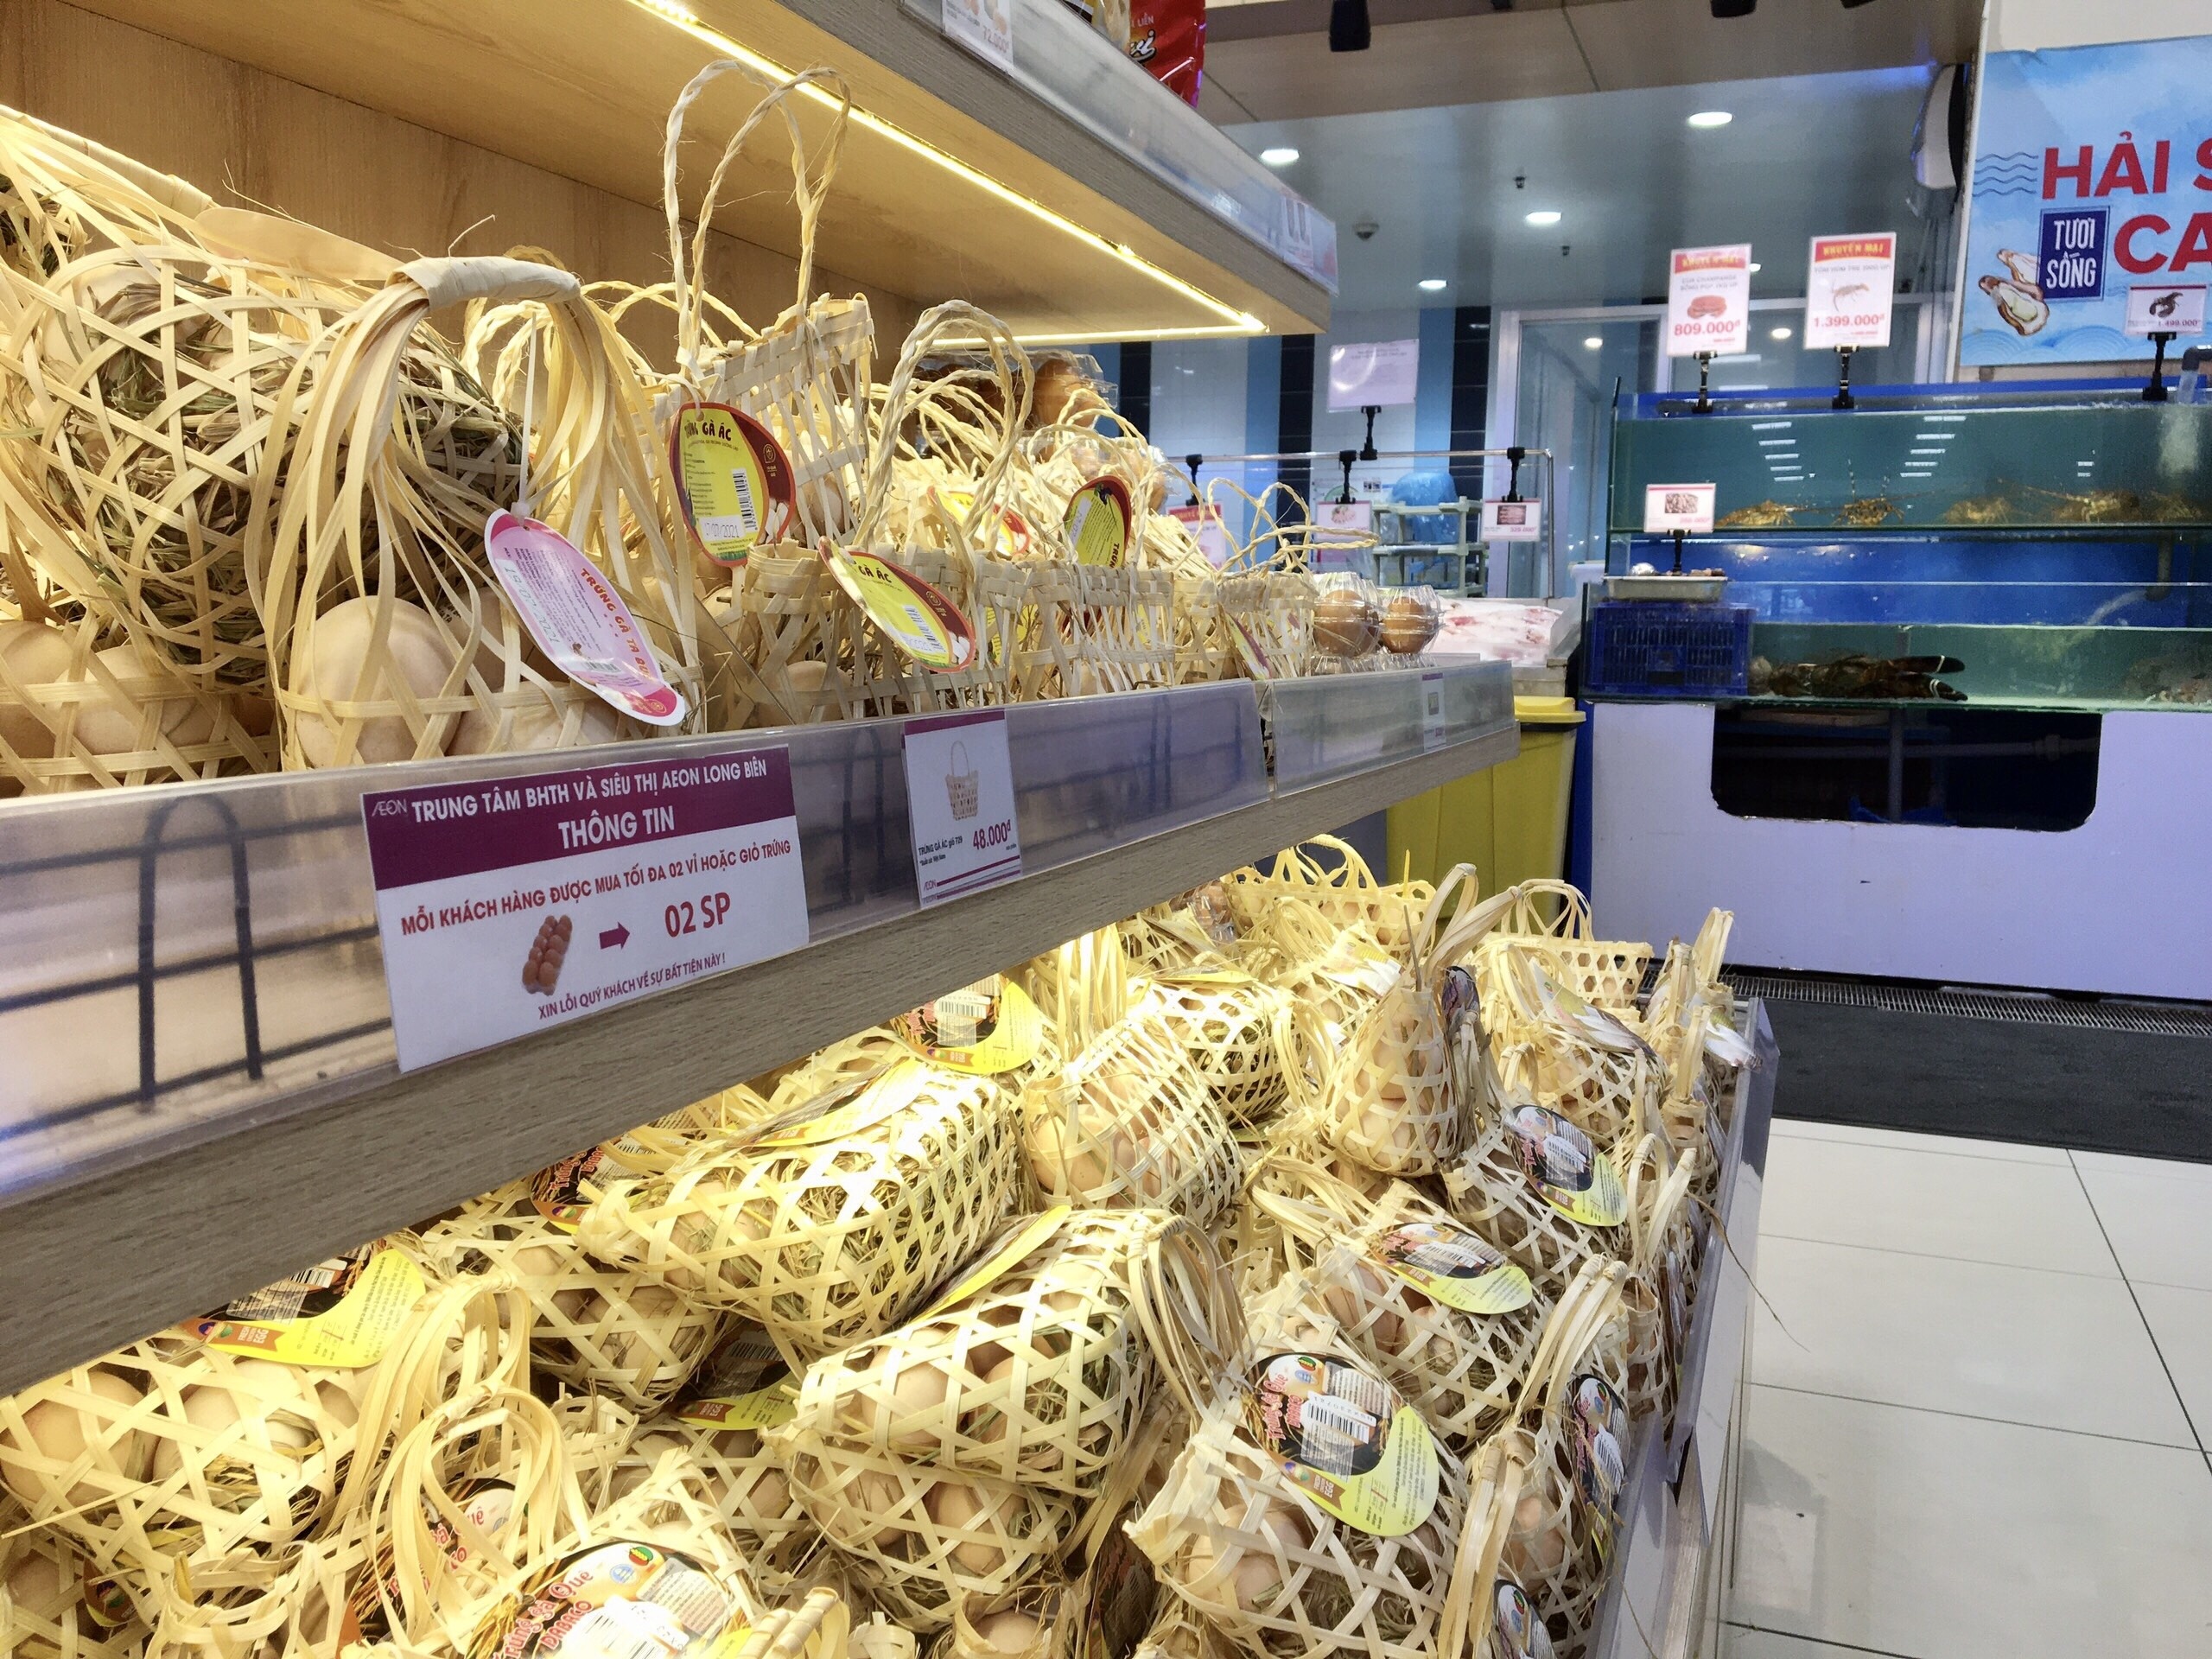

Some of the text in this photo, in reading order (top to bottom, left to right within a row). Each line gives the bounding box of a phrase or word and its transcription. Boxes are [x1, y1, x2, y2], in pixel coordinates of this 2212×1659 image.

[2042, 130, 2171, 200] HẢI
[2046, 251, 2097, 289] SỐNG
[702, 419, 715, 436] GÀ
[718, 422, 732, 442] ÁC
[858, 563, 892, 583] GÀ ÁC
[614, 615, 631, 633] GÀ
[411, 795, 478, 823] TRUNG
[481, 786, 521, 813] TÂM
[525, 783, 569, 807] BHTH
[573, 775, 598, 801] VÀ
[601, 772, 631, 798] SIÊU
[634, 772, 658, 796] THỊ
[662, 767, 701, 790] AEON
[703, 762, 741, 784] LONG
[744, 756, 767, 778] BIÊN
[558, 805, 675, 849] THÔNG TIN
[401, 838, 791, 936] MỖI KHÁCH HÀNG ĐƯỢC MUA TỐI ĐA 02 VỈ HOẶC GIỎ TRỨNG
[664, 892, 731, 938] 02 SP
[537, 1001, 558, 1020] XIN
[560, 993, 577, 1013] LỖI
[579, 986, 601, 1008] QUÝ
[603, 978, 636, 1001] KHÁCH
[636, 970, 649, 989] VỀ
[650, 970, 664, 987] SỰ
[664, 962, 683, 982] BẤT
[683, 958, 703, 976] TIỆN
[704, 953, 721, 969] NÀY
[1324, 1480, 1335, 1498] EGG
[540, 1600, 594, 1650] DABACO
